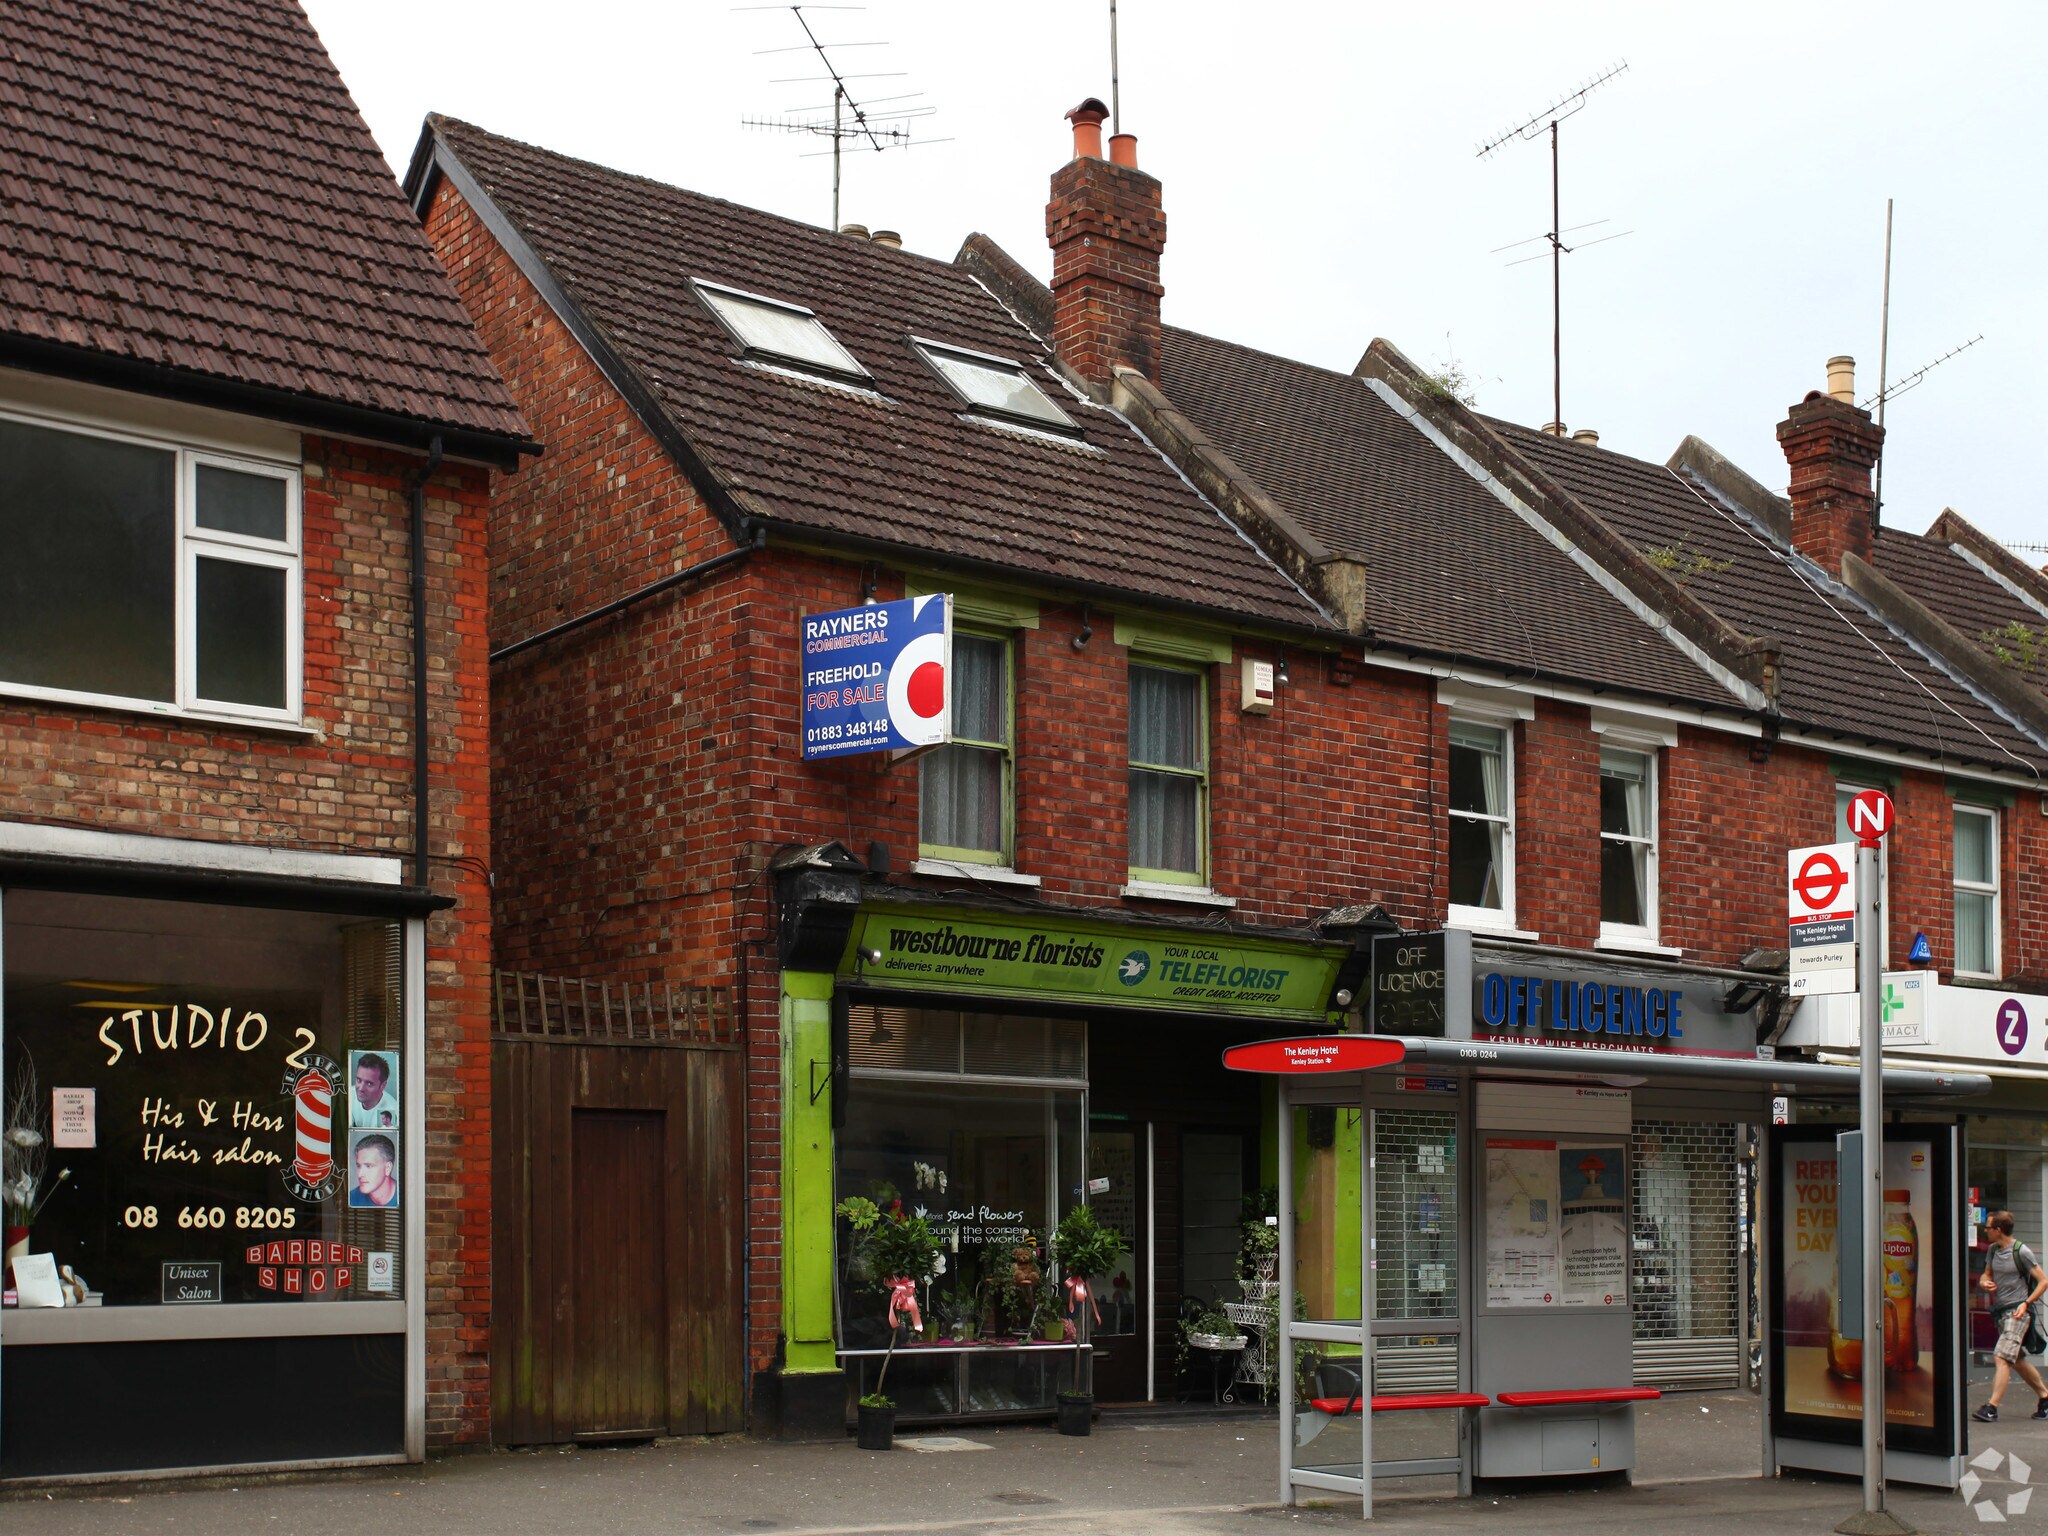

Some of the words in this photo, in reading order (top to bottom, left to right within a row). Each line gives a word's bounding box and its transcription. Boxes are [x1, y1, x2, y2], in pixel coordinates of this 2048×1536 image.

[806, 610, 889, 639] RAYNERS
[806, 630, 889, 654] COMMERCIAL
[807, 662, 882, 686] FREEHOLD
[807, 690, 840, 711] FOR
[843, 683, 885, 708] SALE
[808, 725, 842, 742] 01883
[845, 719, 888, 738] 348148
[808, 736, 888, 755] raynerscommercial.com
[1855, 798, 1885, 832] N
[1806, 926, 1827, 934] Kenley
[1828, 924, 1846, 932] Hotel
[890, 926, 1022, 962] westbourne
[1022, 934, 1105, 968] florists
[1164, 947, 1189, 958] YOUR
[1191, 949, 1219, 961] LOCAL
[1396, 946, 1428, 966] OFF
[885, 958, 932, 972] deliveries
[935, 964, 985, 976] anywhere
[1159, 960, 1290, 991] TELEFLORIST
[1379, 970, 1445, 992] LICENCE
[1794, 978, 1806, 988] 407
[1905, 980, 1919, 988] NHS
[1172, 986, 1204, 997] CREDIT
[1206, 989, 1233, 999] CARDS
[1234, 992, 1281, 1003] ACCEPTED
[1482, 972, 1544, 1027] OFF
[1551, 980, 1683, 1038] LICENCE
[99, 1004, 268, 1066] STUDIO
[286, 1027, 316, 1070] 2
[2004, 1009, 2019, 1045] Z
[1284, 1048, 1296, 1056] The
[1298, 1046, 1319, 1057] Kenley
[1320, 1046, 1339, 1054] Hotel
[1460, 1048, 1478, 1058] 0108
[1480, 1050, 1498, 1060] 0244
[1545, 1040, 1577, 1048] WINE
[142, 1097, 185, 1128] His
[198, 1098, 219, 1126] &
[232, 1101, 284, 1132] Hers
[143, 1134, 201, 1164] Hair
[213, 1136, 282, 1165] salon
[292, 1183, 335, 1200] SHOP
[124, 1206, 158, 1228] 08
[178, 1206, 226, 1228] 660
[235, 1207, 296, 1229] 8205
[947, 1205, 974, 1222] send
[978, 1205, 1024, 1224] flowers
[962, 1226, 982, 1234] the
[962, 1234, 982, 1244] the
[985, 1234, 1025, 1244] world
[250, 1242, 361, 1262] BARBER
[1796, 1232, 1834, 1252] DAY
[1884, 1244, 1911, 1254] Lipton
[169, 1266, 208, 1280] Unisex
[262, 1269, 348, 1290] SHOP
[177, 1286, 212, 1300] Salon
